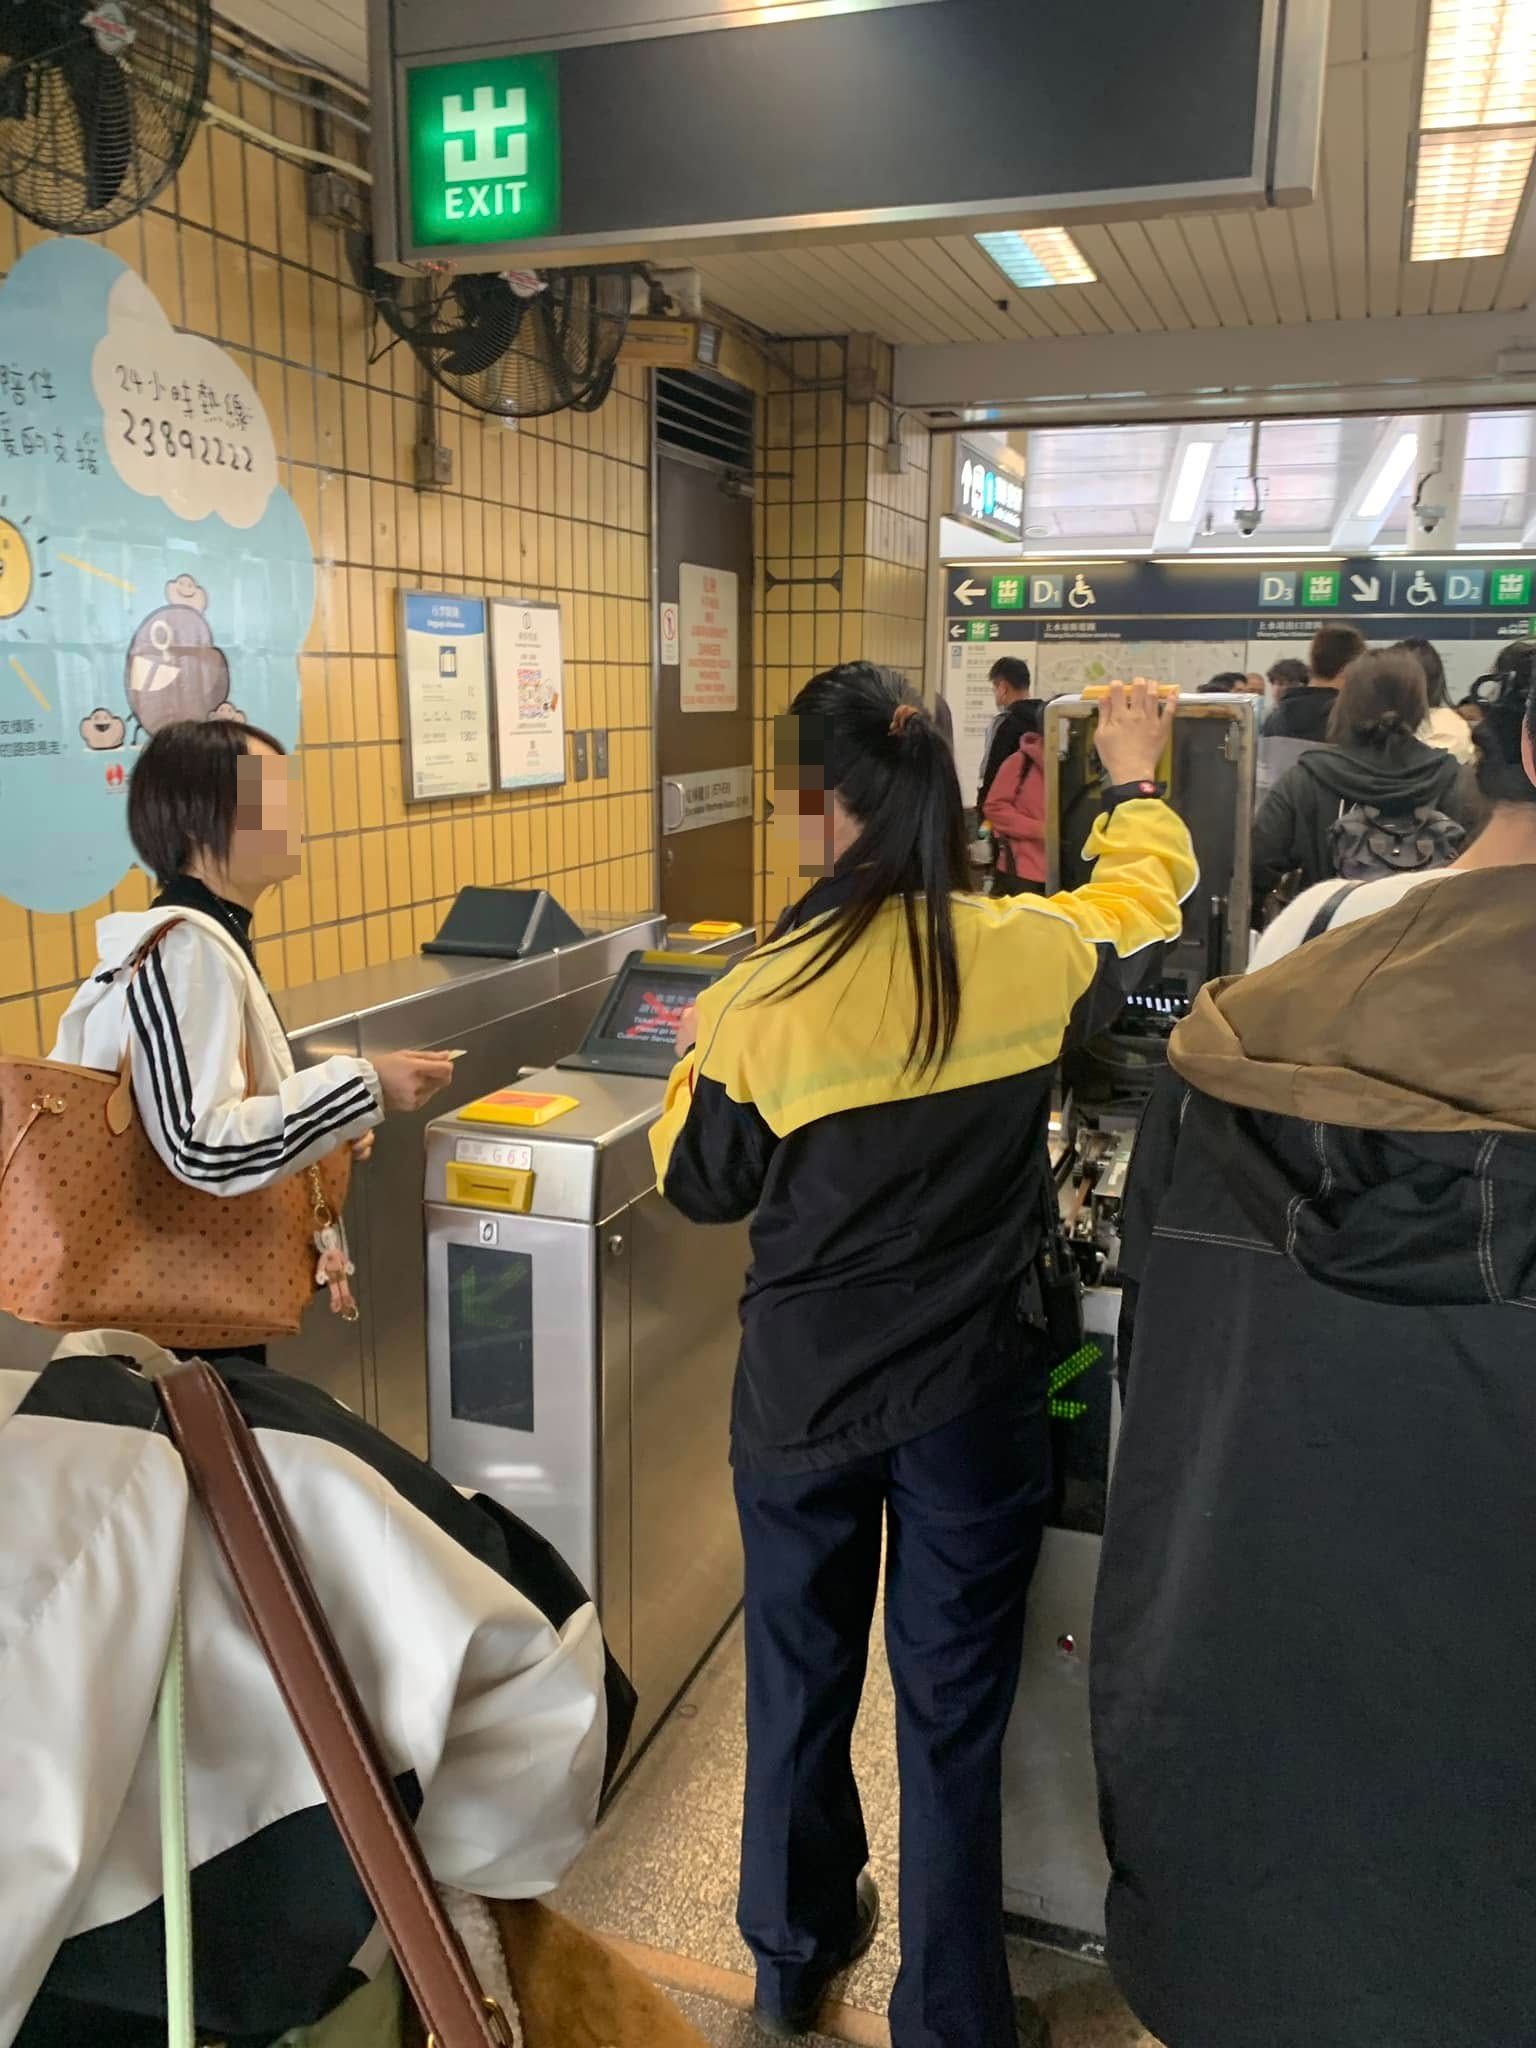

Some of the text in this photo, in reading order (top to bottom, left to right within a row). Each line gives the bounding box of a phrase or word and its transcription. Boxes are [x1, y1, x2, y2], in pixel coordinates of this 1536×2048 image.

[443, 86, 528, 183] 出
[445, 181, 528, 220] EXIT
[120, 408, 253, 473] 23892222
[1033, 581, 1060, 603] D1
[1263, 577, 1295, 601] D3
[1448, 576, 1481, 600] D2
